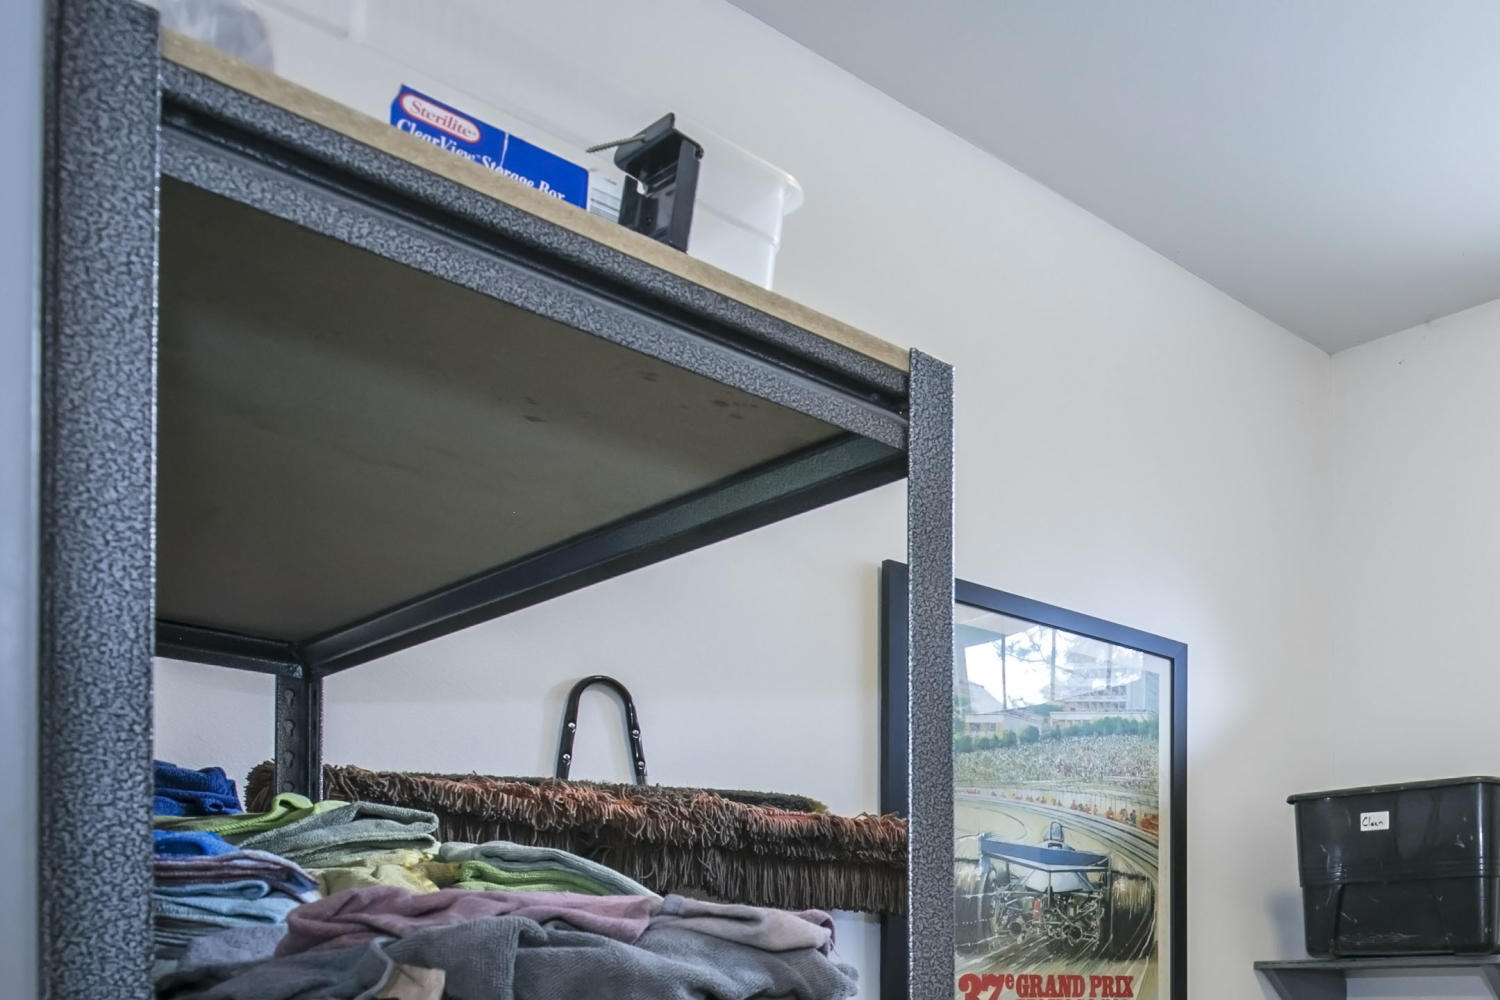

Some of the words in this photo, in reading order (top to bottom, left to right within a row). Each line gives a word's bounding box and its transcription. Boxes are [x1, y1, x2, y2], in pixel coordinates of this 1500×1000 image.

[411, 100, 474, 137] Sterilite
[1015, 974, 1086, 998] GRAND
[1089, 975, 1134, 998] PRIX
